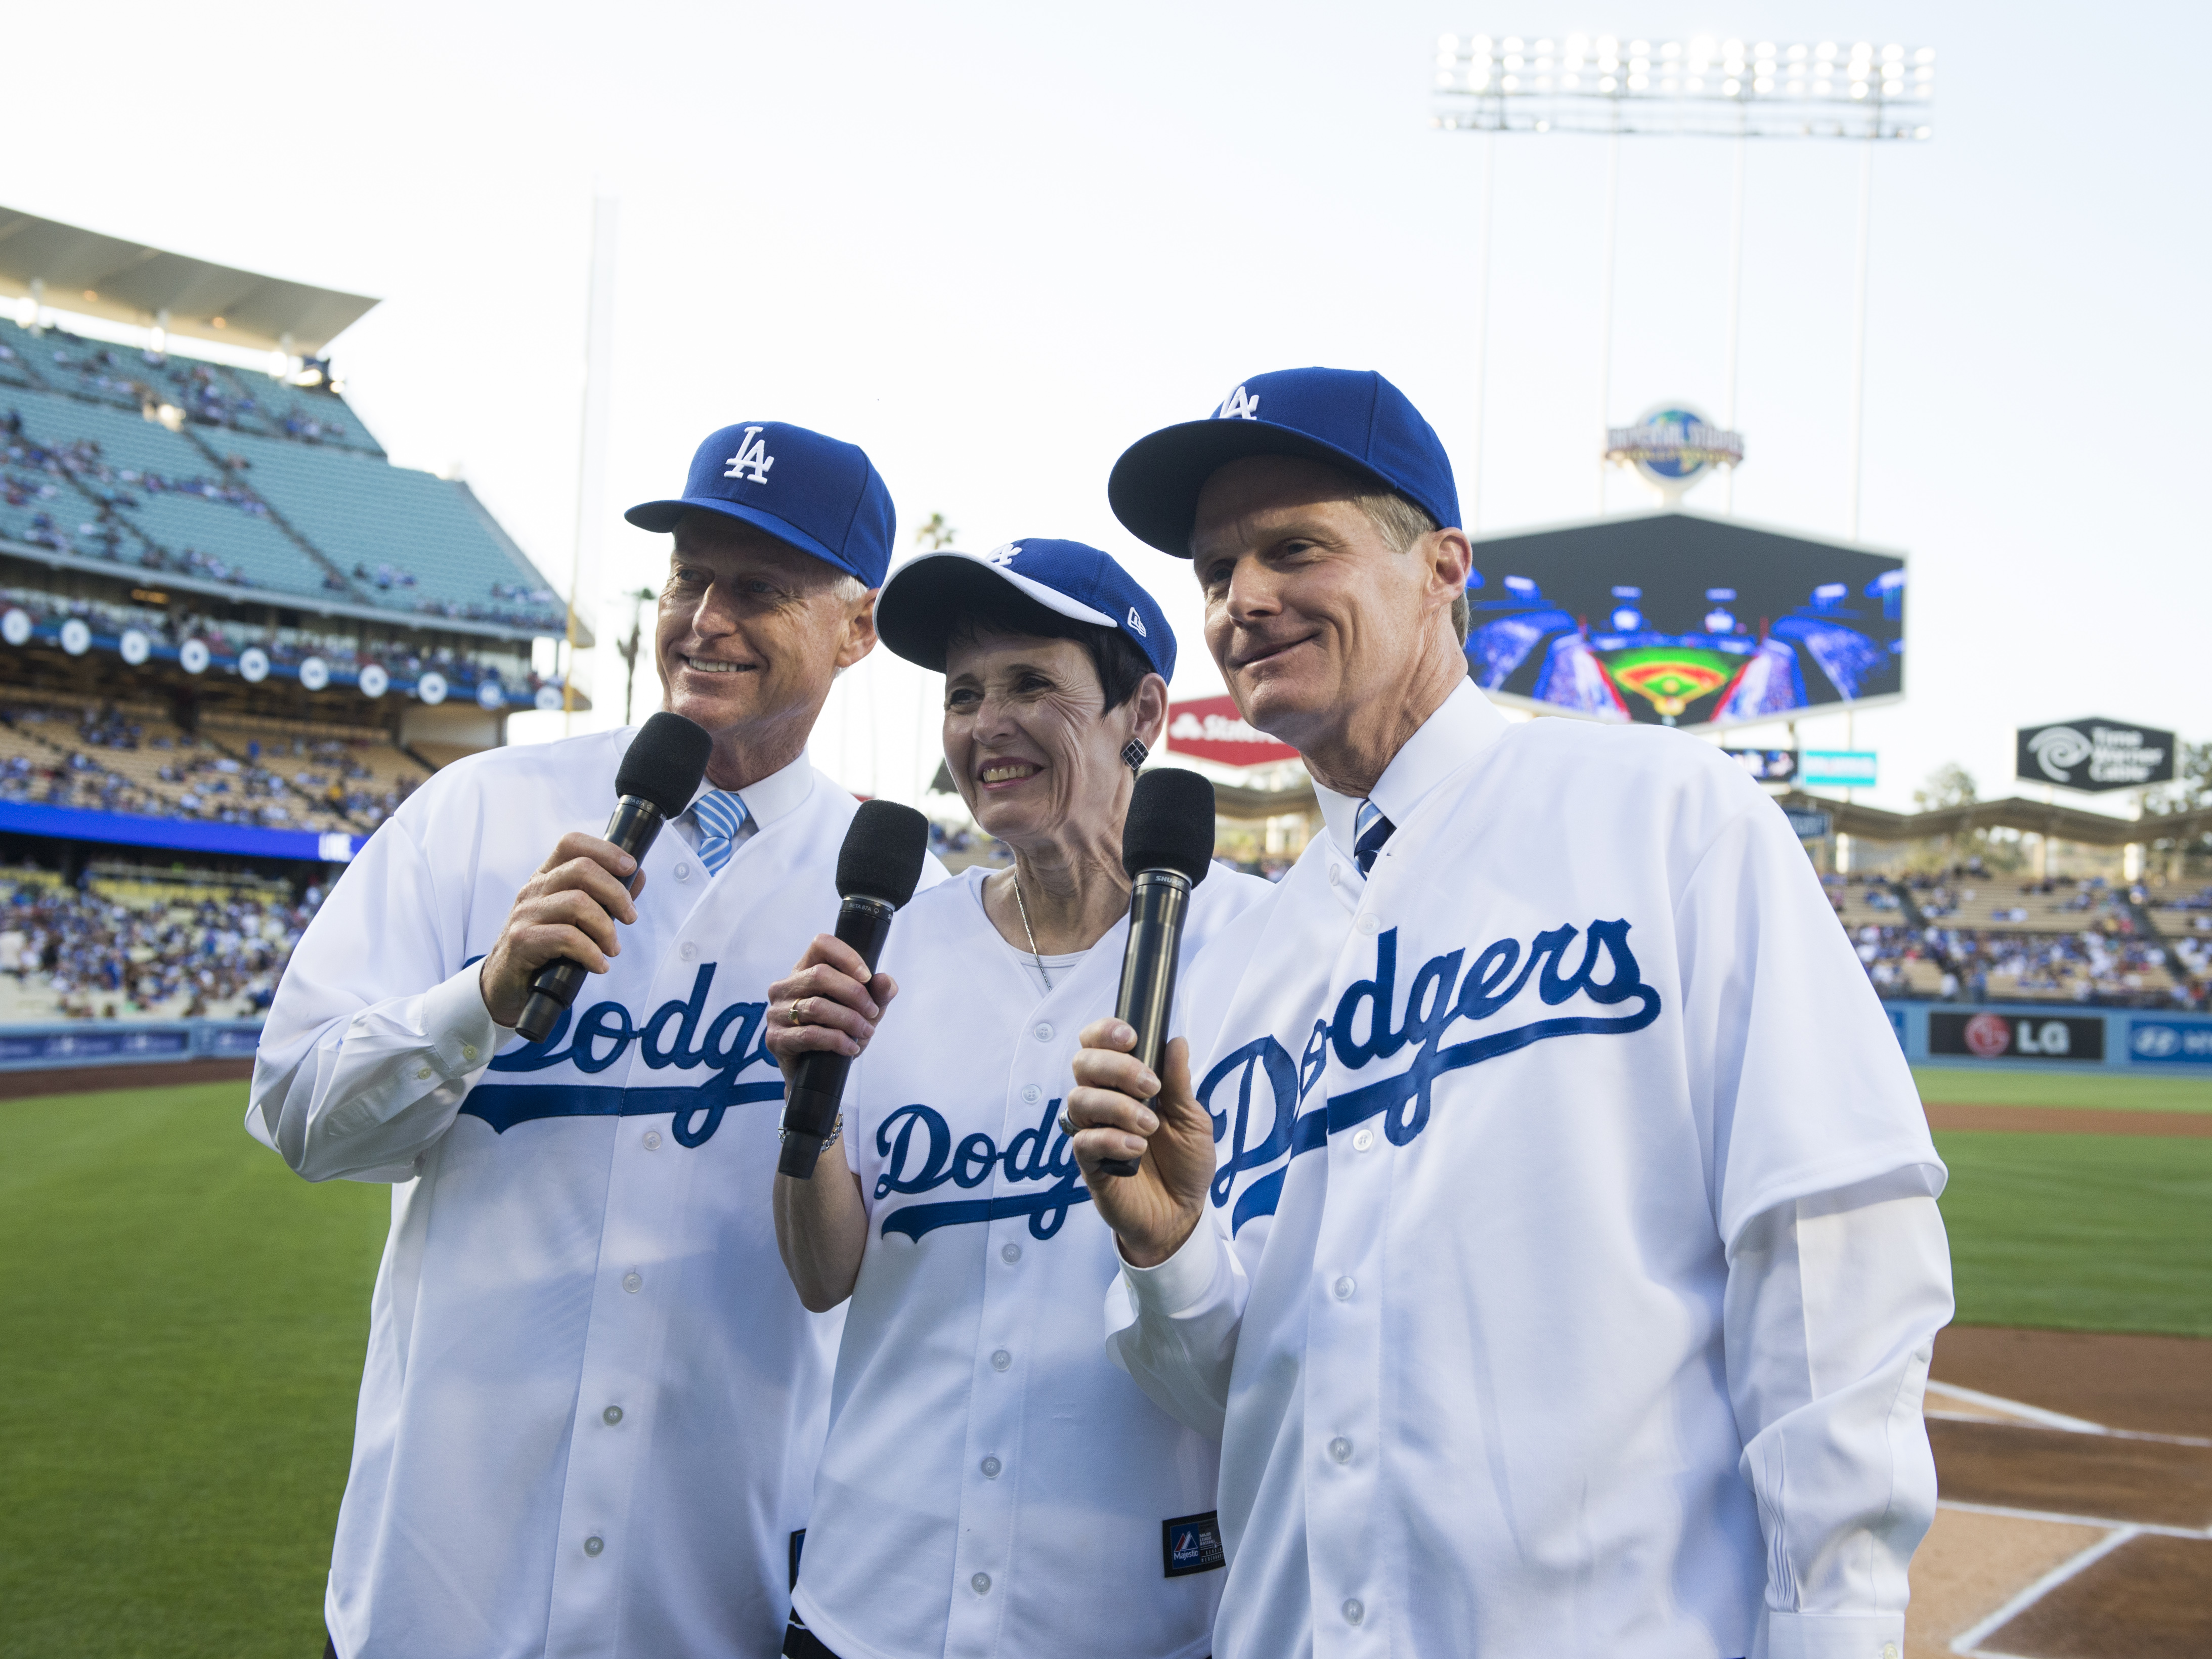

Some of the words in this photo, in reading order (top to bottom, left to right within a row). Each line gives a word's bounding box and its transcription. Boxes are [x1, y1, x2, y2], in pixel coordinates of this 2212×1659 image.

[1219, 382, 1260, 420] LA
[724, 426, 774, 485] LA
[2092, 727, 2141, 745] Time
[2092, 745, 2162, 764] Warner
[2090, 762, 2148, 781] Cable
[1155, 875, 1183, 887] SHURE
[2017, 1020, 2070, 1055] LG
[1174, 1549, 1199, 1560] Majestic
